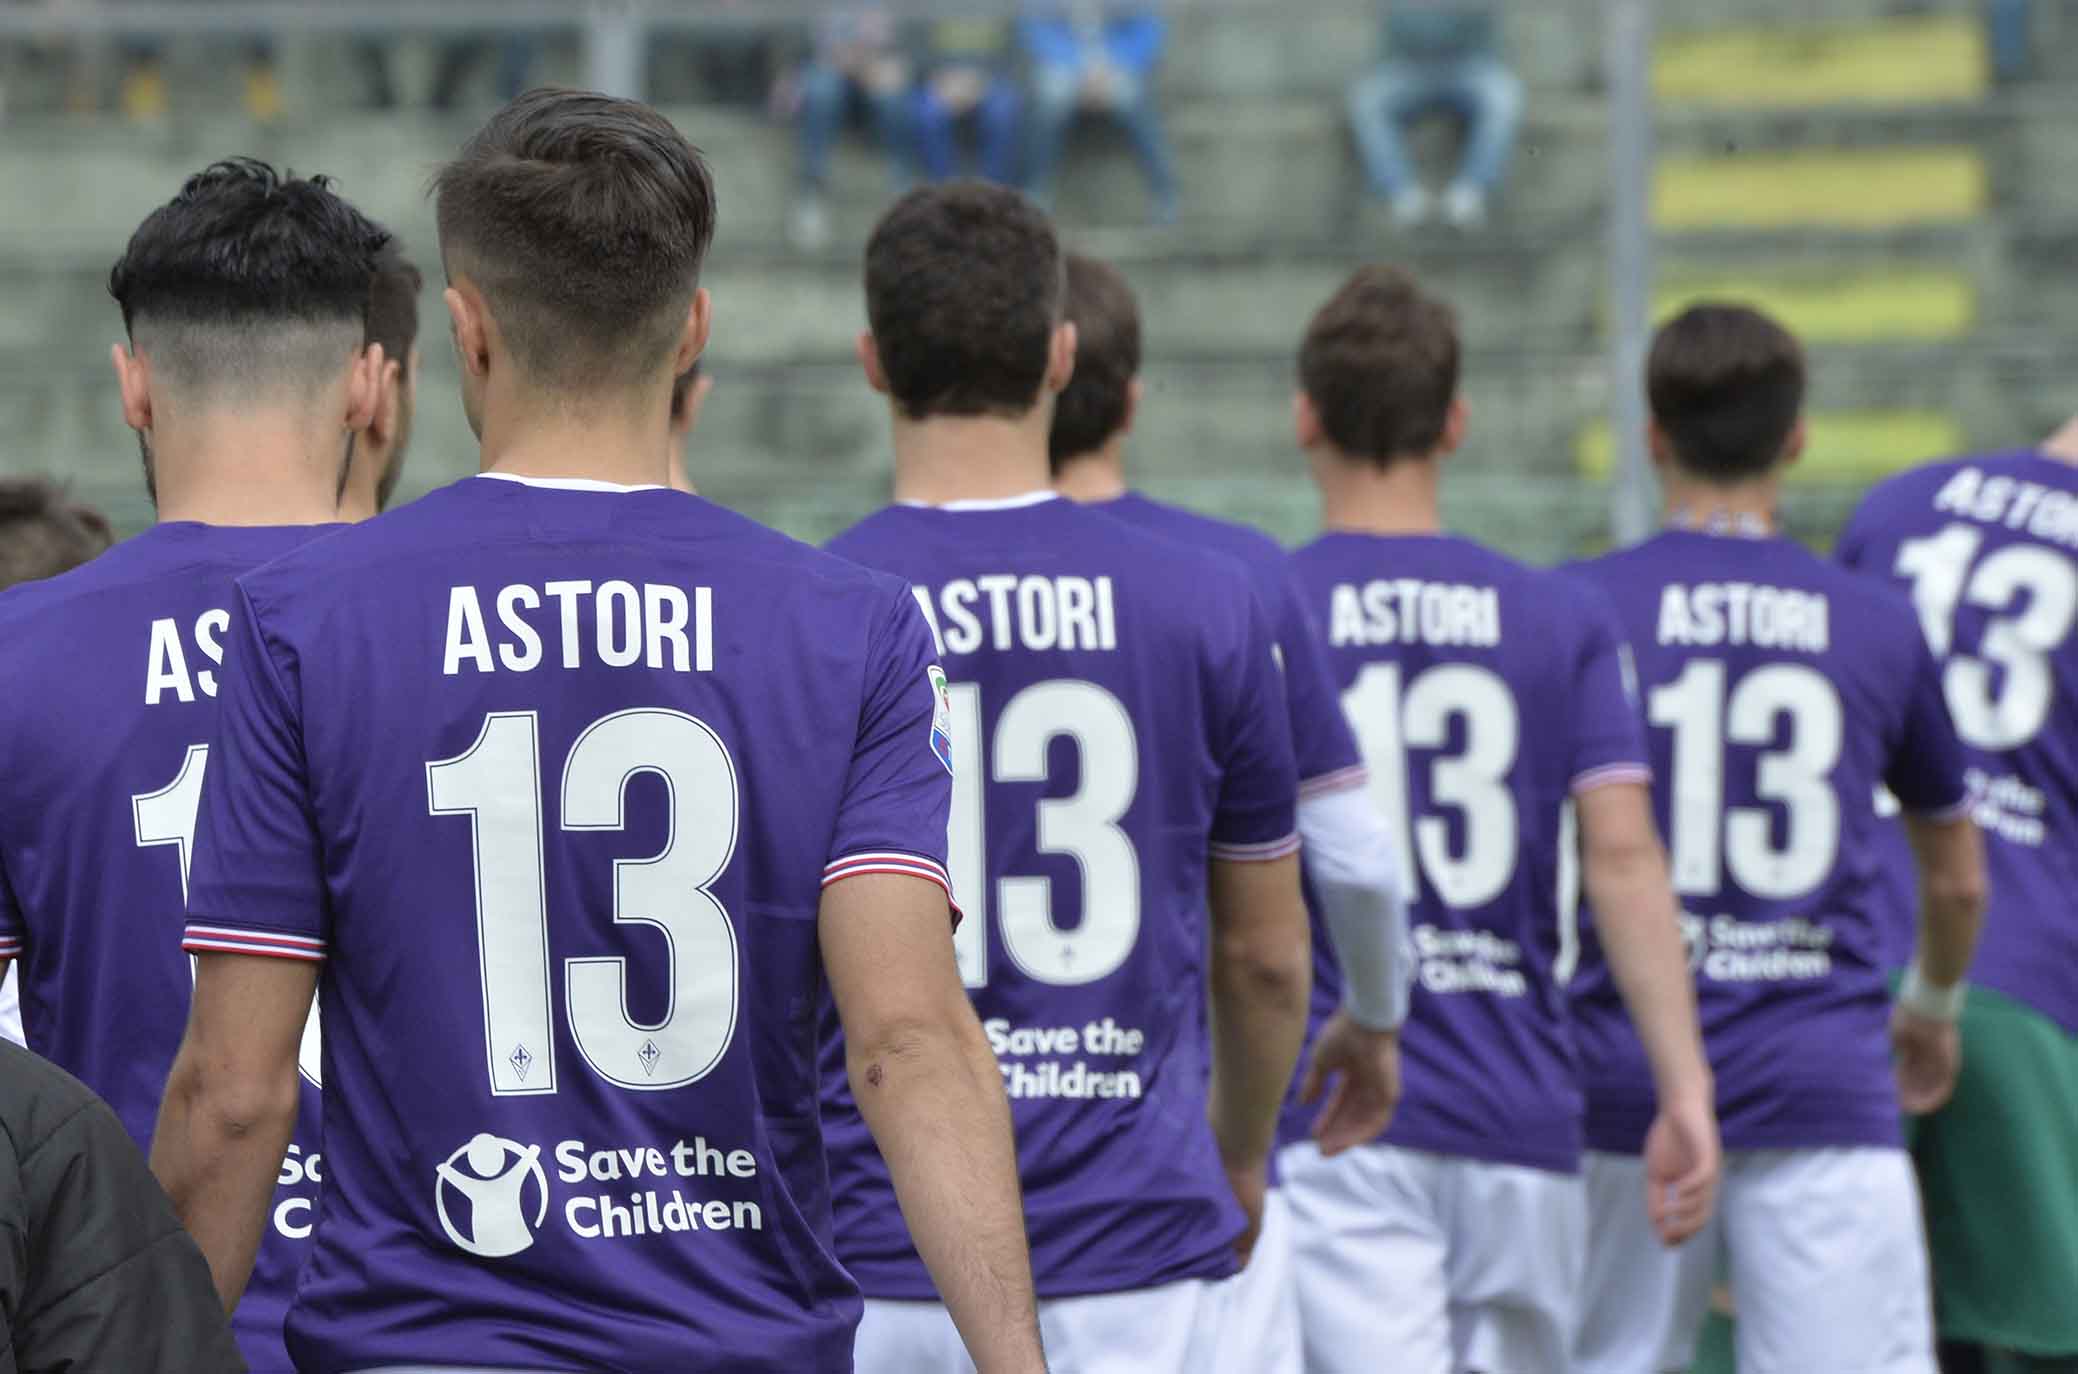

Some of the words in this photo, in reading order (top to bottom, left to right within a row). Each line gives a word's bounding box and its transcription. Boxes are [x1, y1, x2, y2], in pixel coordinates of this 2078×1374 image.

[444, 580, 713, 675] ASTORI
[1329, 578, 1501, 648] ASTORI
[1656, 581, 1830, 654] ASTORI
[1894, 522, 2078, 750] 13
[1340, 662, 1519, 910] 13
[1646, 660, 1843, 900] 13
[946, 678, 1141, 989] 13
[424, 706, 739, 1097] 13
[984, 1017, 1079, 1055] Save
[1082, 1016, 1144, 1056] the
[555, 1140, 668, 1184] Save
[670, 1136, 757, 1178] the
[564, 1190, 763, 1239] Children
